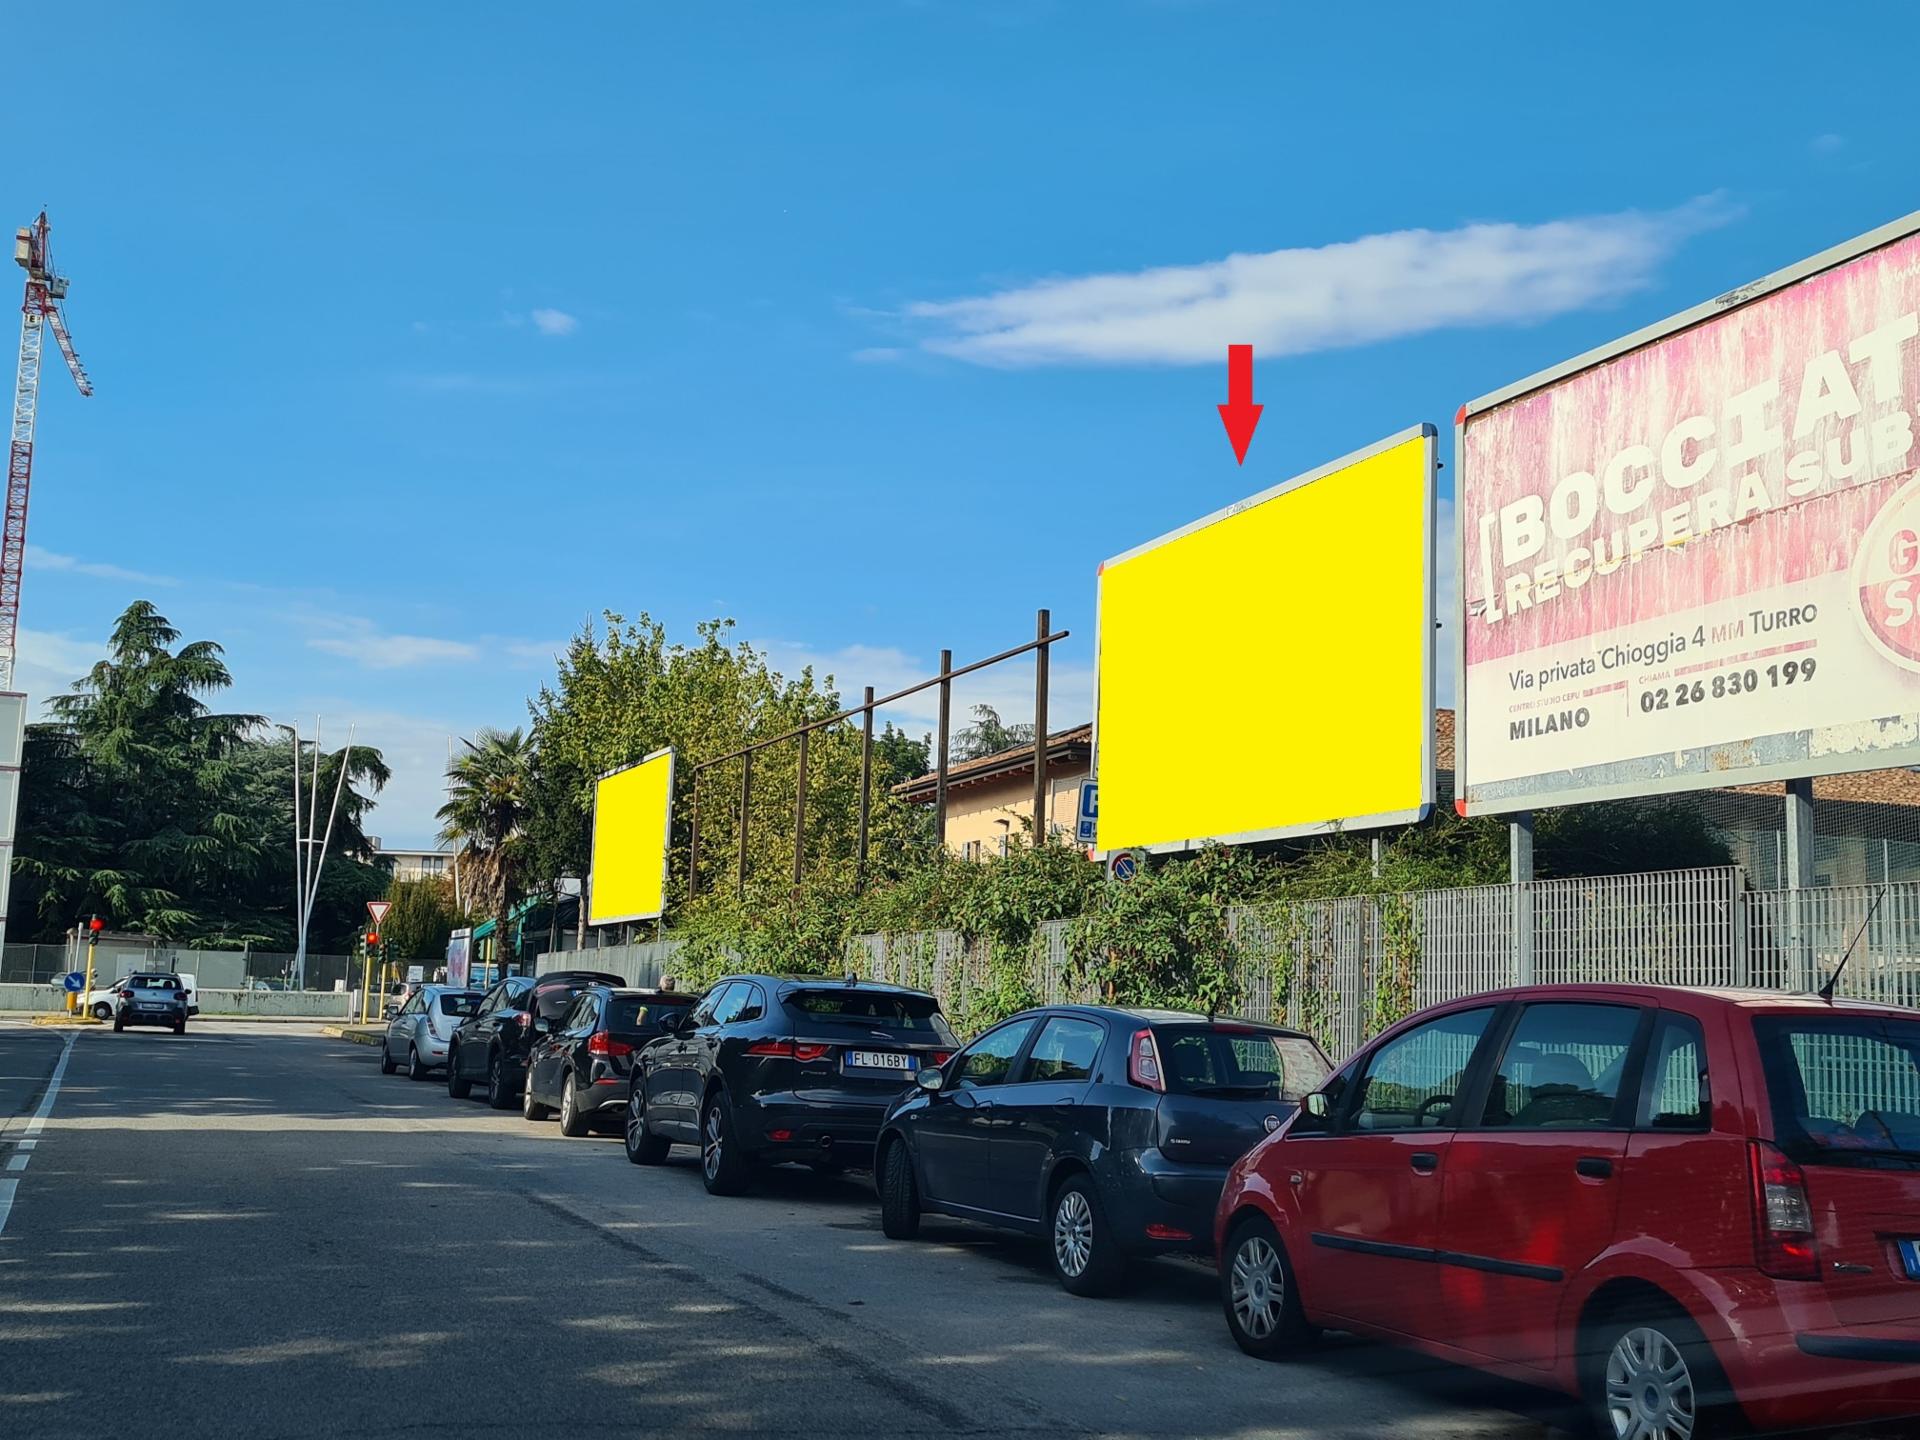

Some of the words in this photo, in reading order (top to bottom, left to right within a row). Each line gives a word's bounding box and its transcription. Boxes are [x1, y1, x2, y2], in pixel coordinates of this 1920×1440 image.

[1500, 311, 1919, 567] BOCCIAT
[1505, 471, 1772, 616] RECUPERA
[1786, 403, 1920, 497] SUB
[1889, 530, 1918, 575] G
[1884, 579, 1920, 628] S
[1508, 669, 1534, 691] Via
[1539, 656, 1596, 692] privata
[1600, 633, 1686, 670] Chioggia
[1692, 625, 1706, 648] 4
[1711, 619, 1744, 645] MM
[1749, 603, 1818, 634] TURRO
[1638, 671, 1671, 685] CHIAMA
[1640, 687, 1669, 713] 02
[1675, 680, 1705, 707] 26
[1712, 669, 1758, 698] 830
[1766, 657, 1818, 688] 199
[1509, 707, 1590, 741] MILANO
